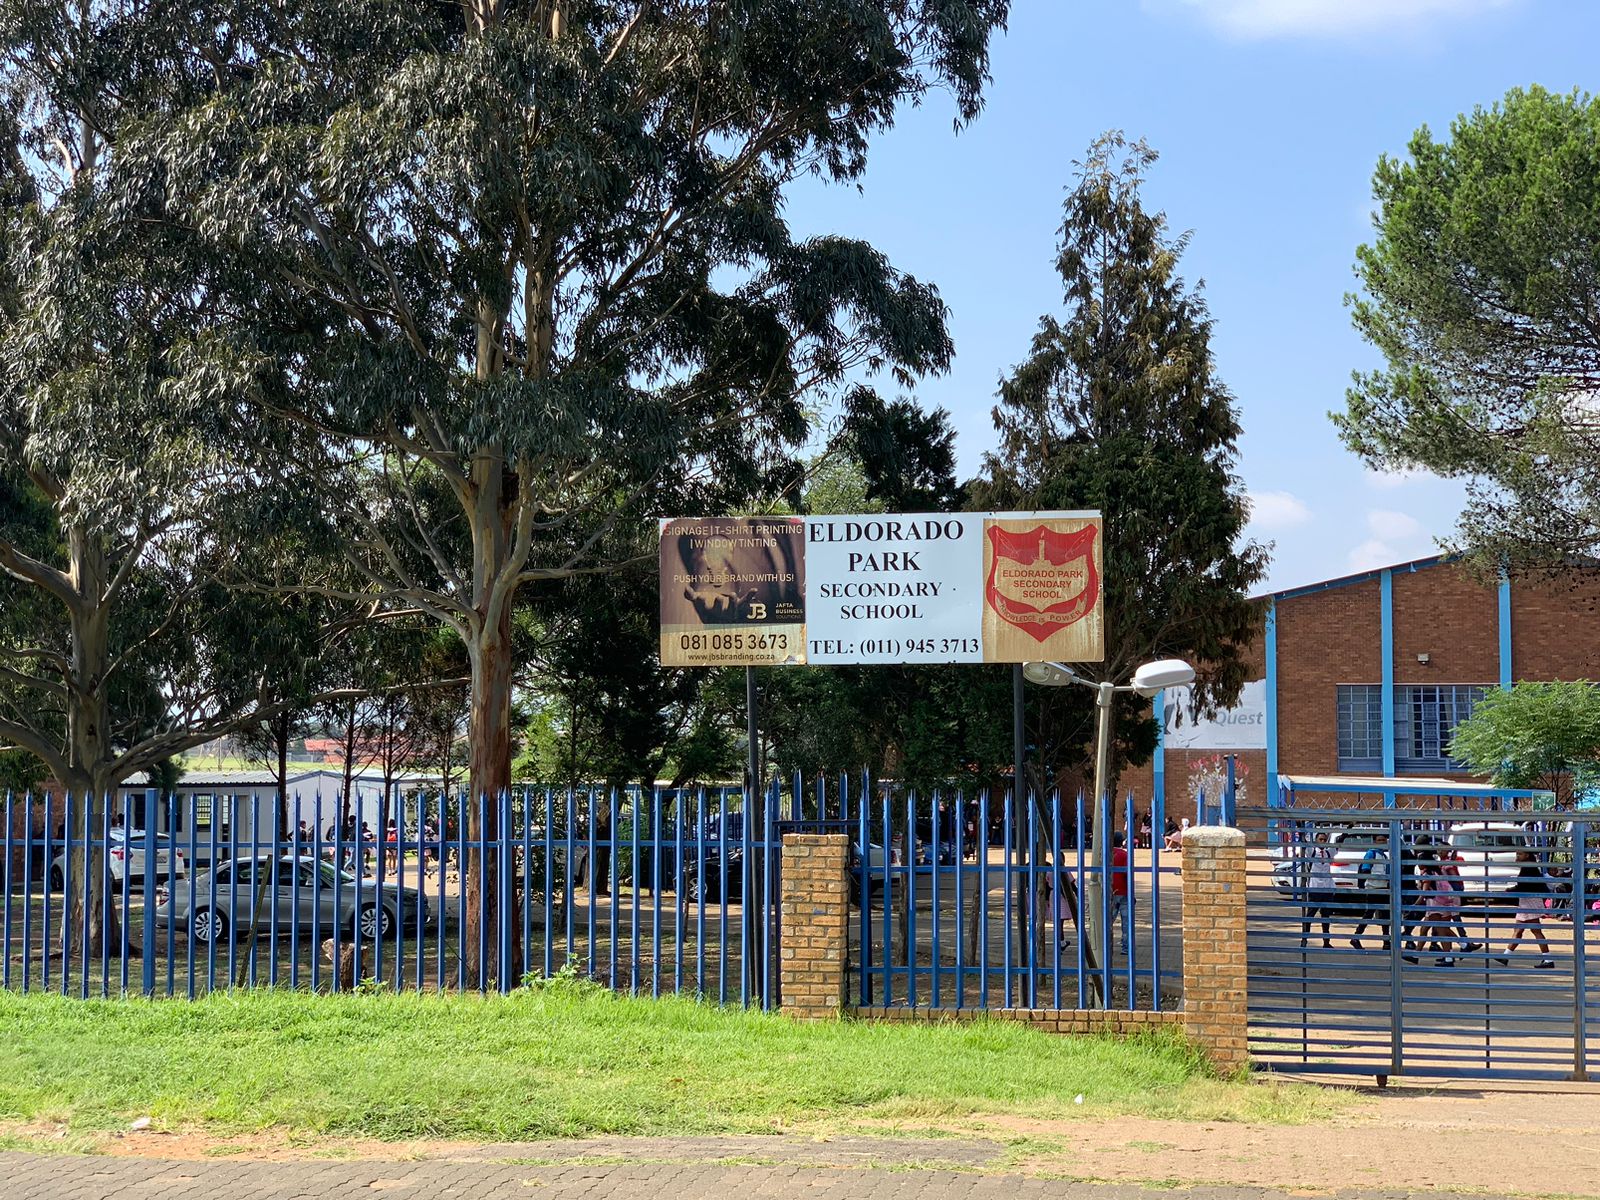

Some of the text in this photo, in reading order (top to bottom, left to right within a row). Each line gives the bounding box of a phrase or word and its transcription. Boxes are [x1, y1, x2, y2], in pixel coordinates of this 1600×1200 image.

[715, 525, 755, 535] T-SHIRT
[756, 524, 803, 535] PRINTING
[809, 520, 964, 543] ELDORADO
[694, 539, 738, 549] WINDOW
[739, 538, 777, 548] TINTING
[848, 551, 922, 572] PARK
[673, 573, 795, 583] PUSH YOUR BRAND WITH US!
[1002, 569, 1083, 578] ELDORADO PARK
[820, 582, 943, 598] SECONDARY
[1013, 580, 1072, 588] SECONDARY
[1022, 590, 1062, 599] SCHOOL
[840, 604, 924, 620] SCHOOL
[1049, 609, 1082, 622] POWER
[680, 633, 788, 650] 081 085 3673
[810, 638, 979, 657] TEL: (011) 945 3713
[688, 653, 775, 661] www.jbsbranding.co.za
